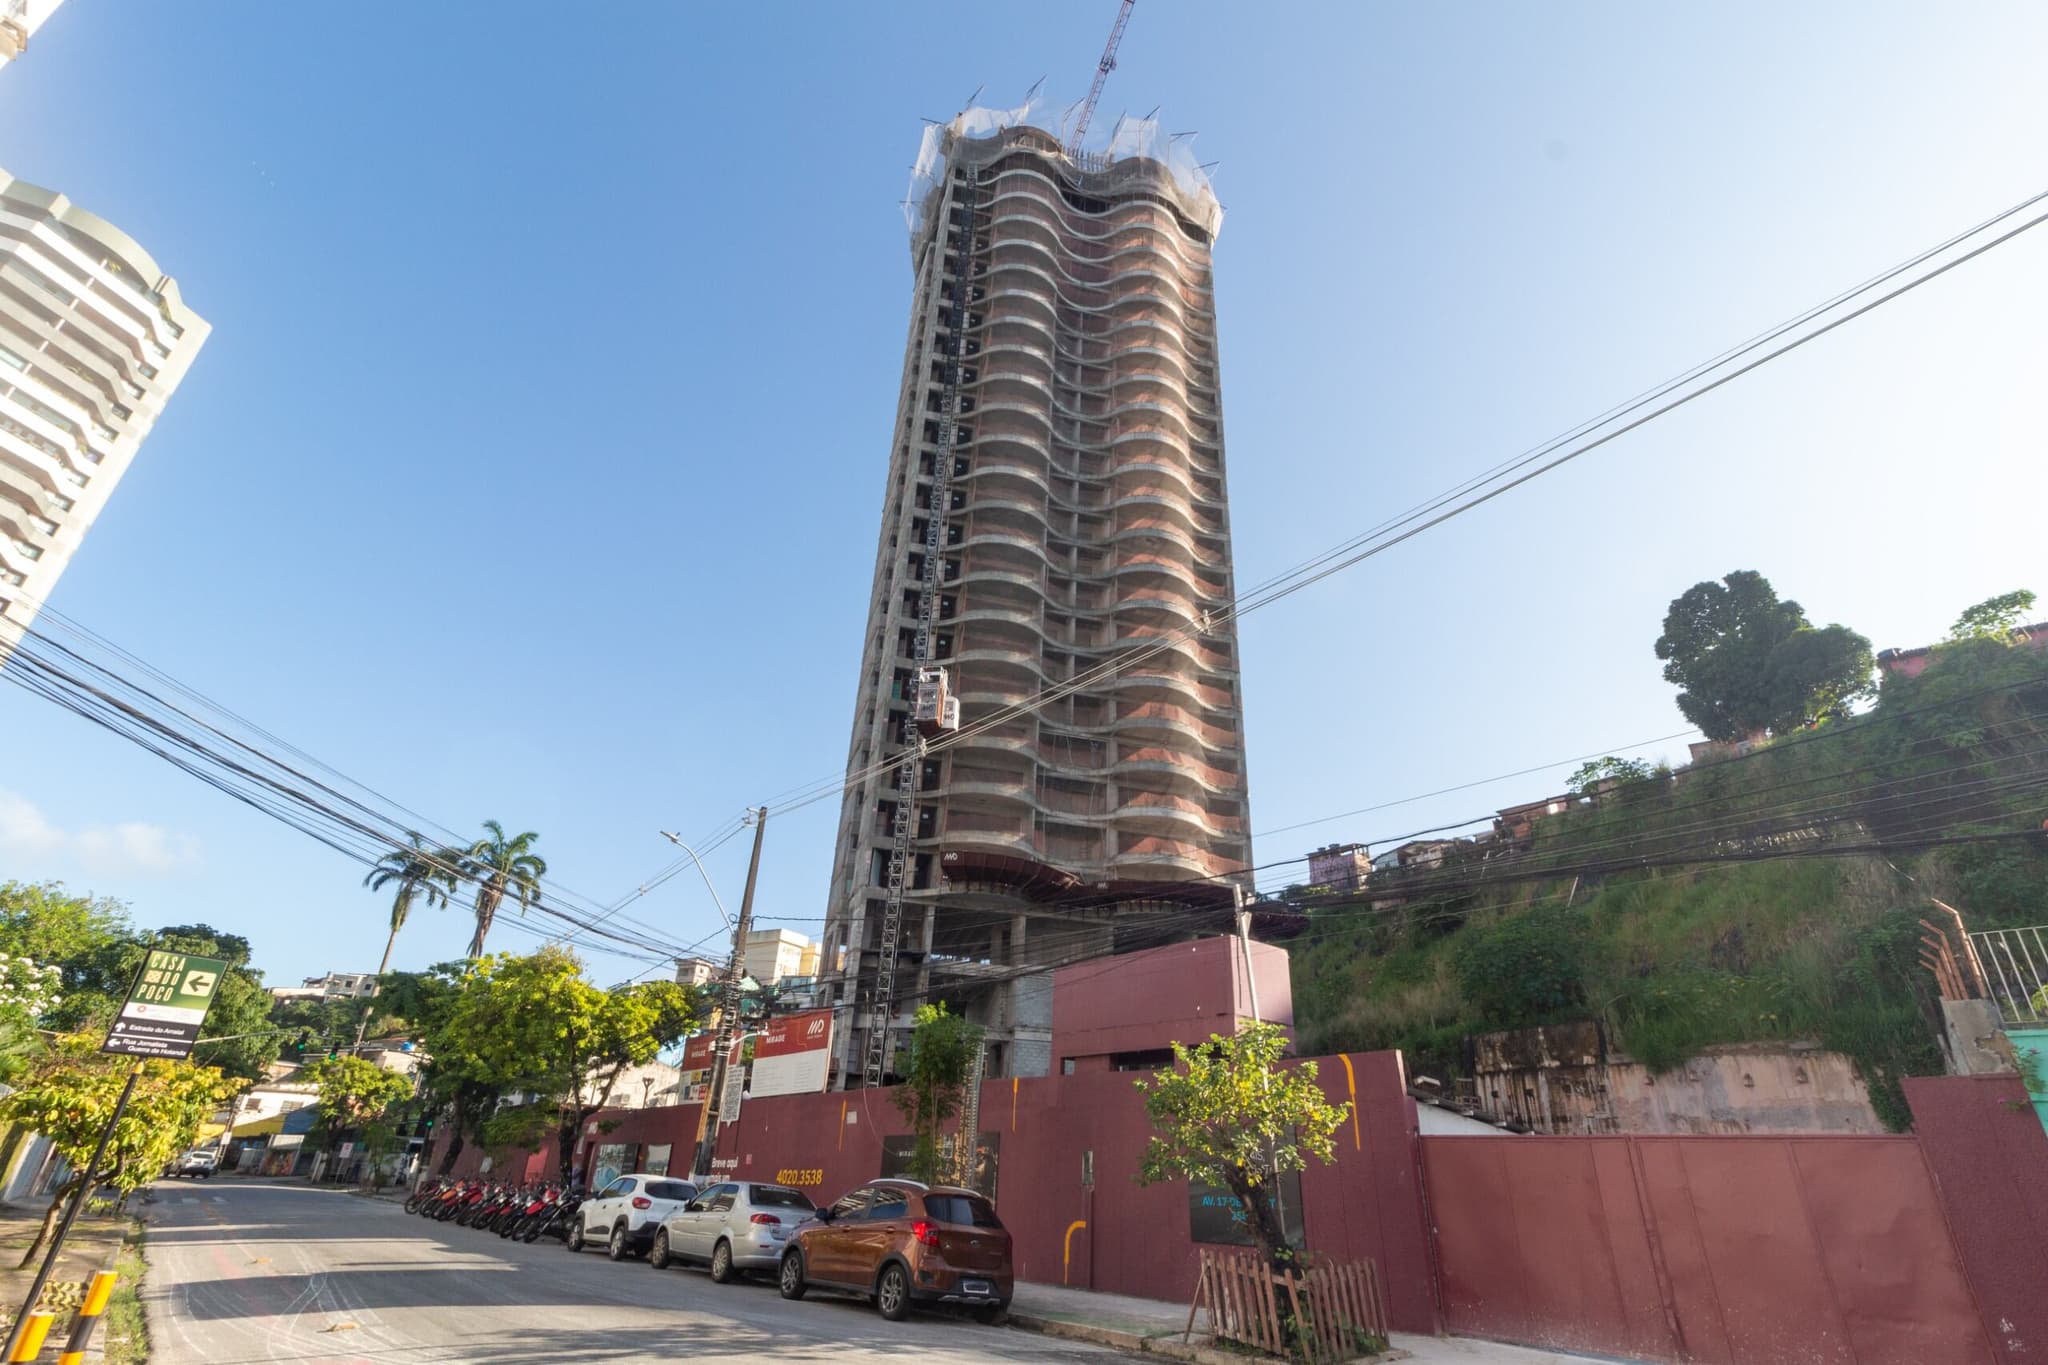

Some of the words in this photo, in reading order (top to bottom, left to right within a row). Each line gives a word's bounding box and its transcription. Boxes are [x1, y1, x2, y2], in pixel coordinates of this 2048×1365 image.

[151, 954, 186, 972] CASA
[161, 971, 180, 986] DO
[776, 1169, 823, 1185] 4020.3538
